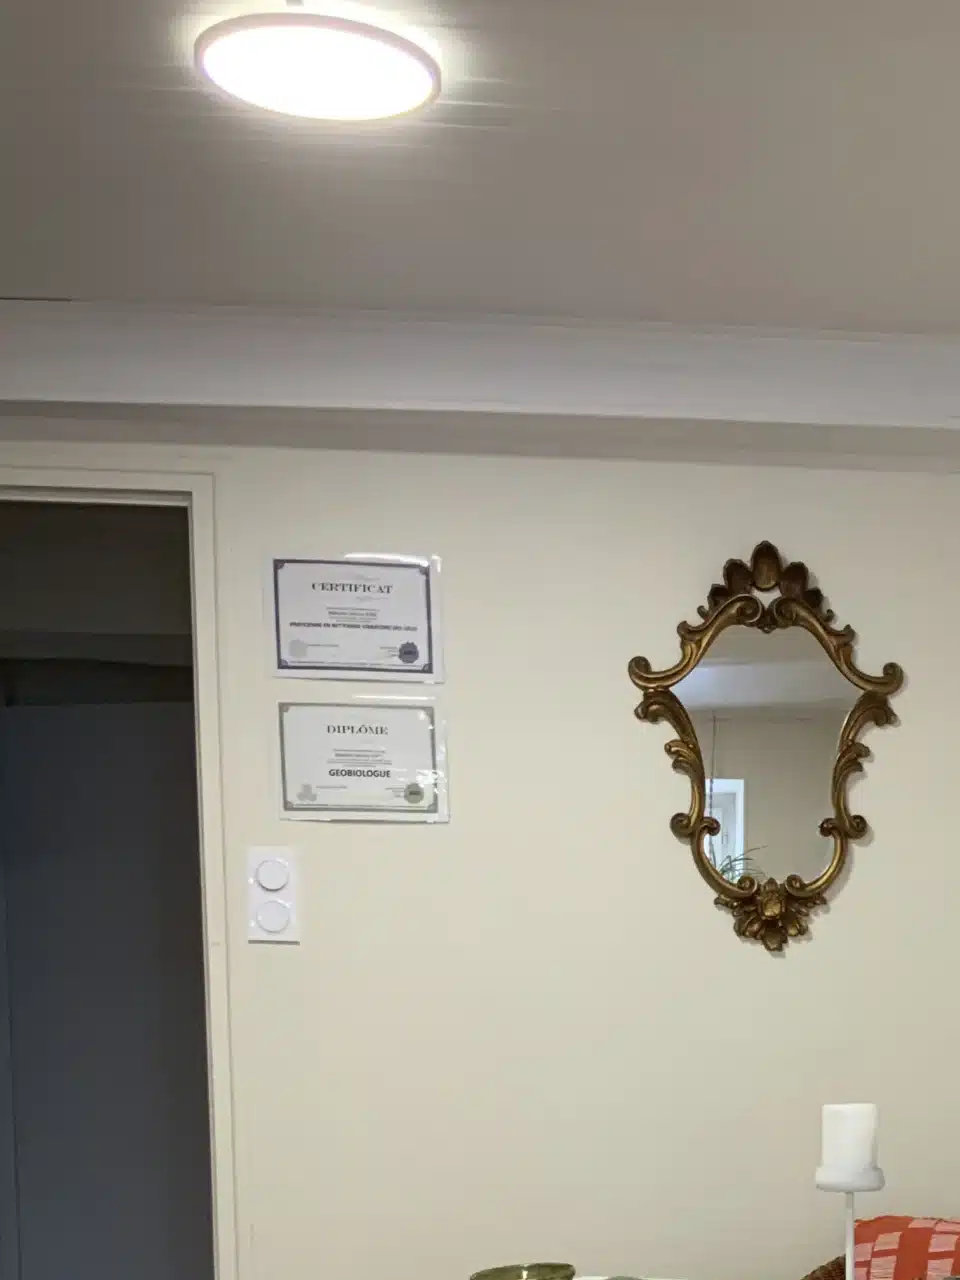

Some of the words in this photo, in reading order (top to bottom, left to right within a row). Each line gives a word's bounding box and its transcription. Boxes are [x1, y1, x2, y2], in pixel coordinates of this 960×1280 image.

[311, 582, 393, 594] CERTIFICAT
[327, 724, 389, 736] DIPLÔME
[328, 769, 391, 778] GEOBIOLOGUE
